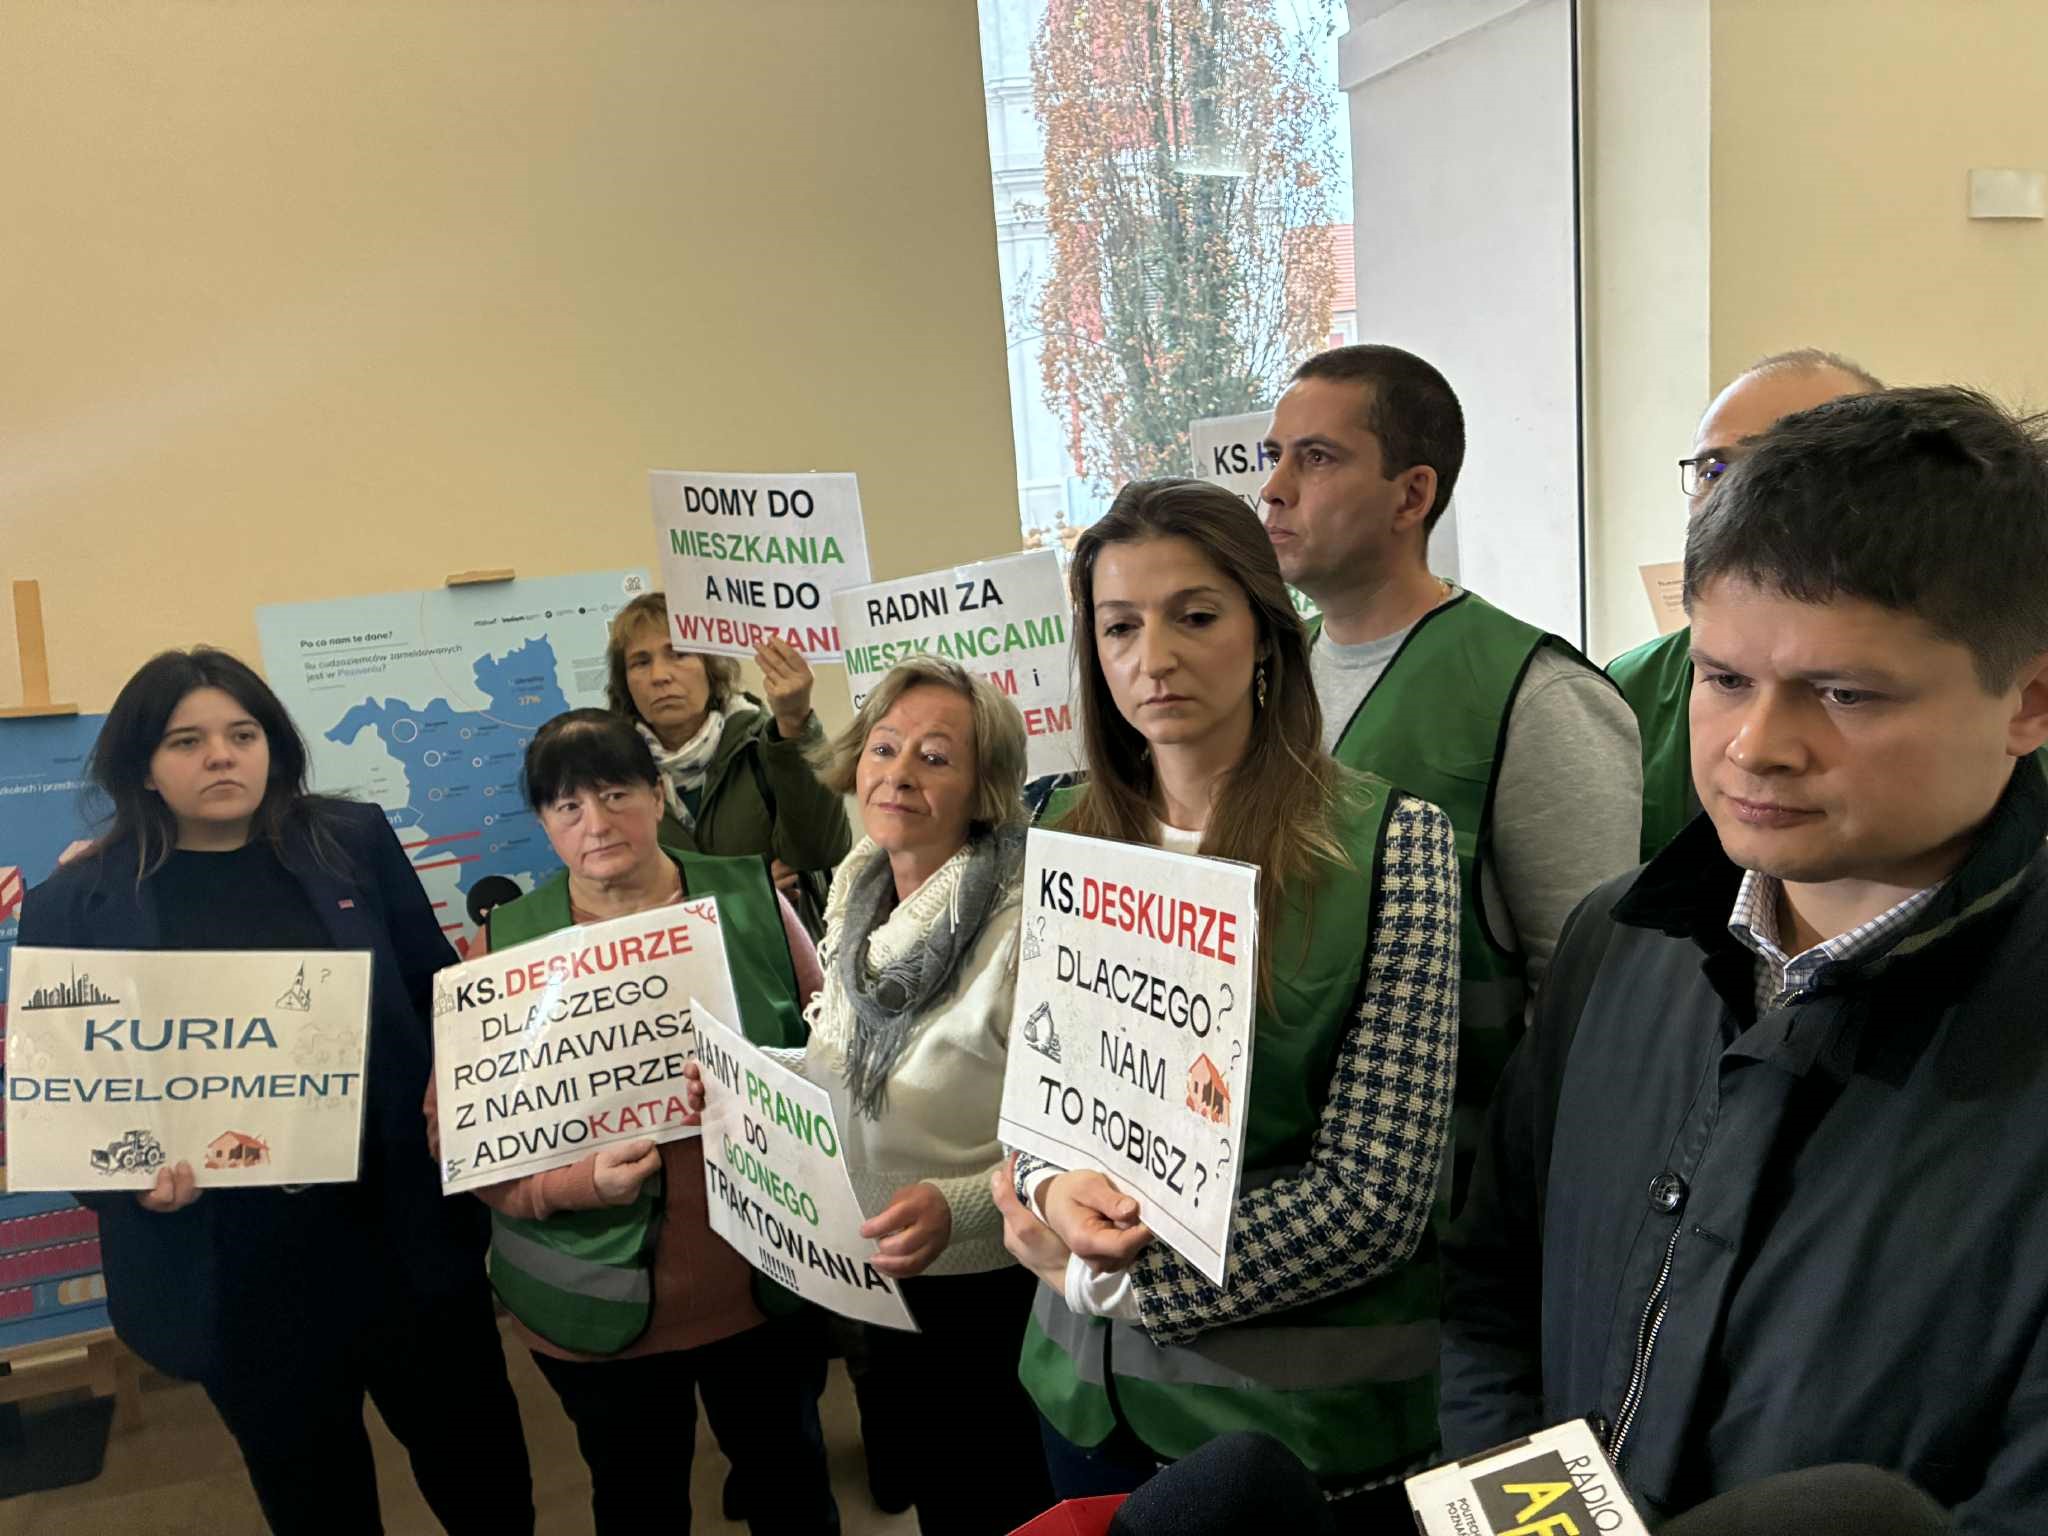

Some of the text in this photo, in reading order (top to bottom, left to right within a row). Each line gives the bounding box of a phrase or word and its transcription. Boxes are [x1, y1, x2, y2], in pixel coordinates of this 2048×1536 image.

[683, 486, 814, 518] DOMY DO
[670, 529, 845, 564] MIESZKANIA
[706, 575, 820, 610] A NIE DO
[867, 578, 1003, 627] RADNI ZA
[1033, 668, 1041, 687] i
[1040, 867, 1237, 966] KS.DESKURZE
[456, 925, 694, 1012] KS.DESKURZE
[1056, 944, 1211, 1038] DLACZEGO
[84, 1017, 278, 1051] KURIA
[481, 974, 669, 1042] DLACZEGO
[454, 1008, 692, 1090] ROZMAWIASZ
[1099, 1029, 1167, 1101] NAM
[10, 1072, 360, 1102] DEVELOPMENT
[456, 1049, 694, 1131] Z NAMI PRZE
[744, 1068, 838, 1158] PRAWO
[472, 1095, 690, 1168] ADWOKATA
[743, 1114, 768, 1155] DO
[1039, 1075, 1084, 1126] TO
[1092, 1096, 1187, 1196] ROBISZ
[723, 1132, 820, 1227] GODNEGO
[706, 1158, 892, 1294] TRAKTOWANIA
[1565, 1454, 1623, 1532] RADIO
